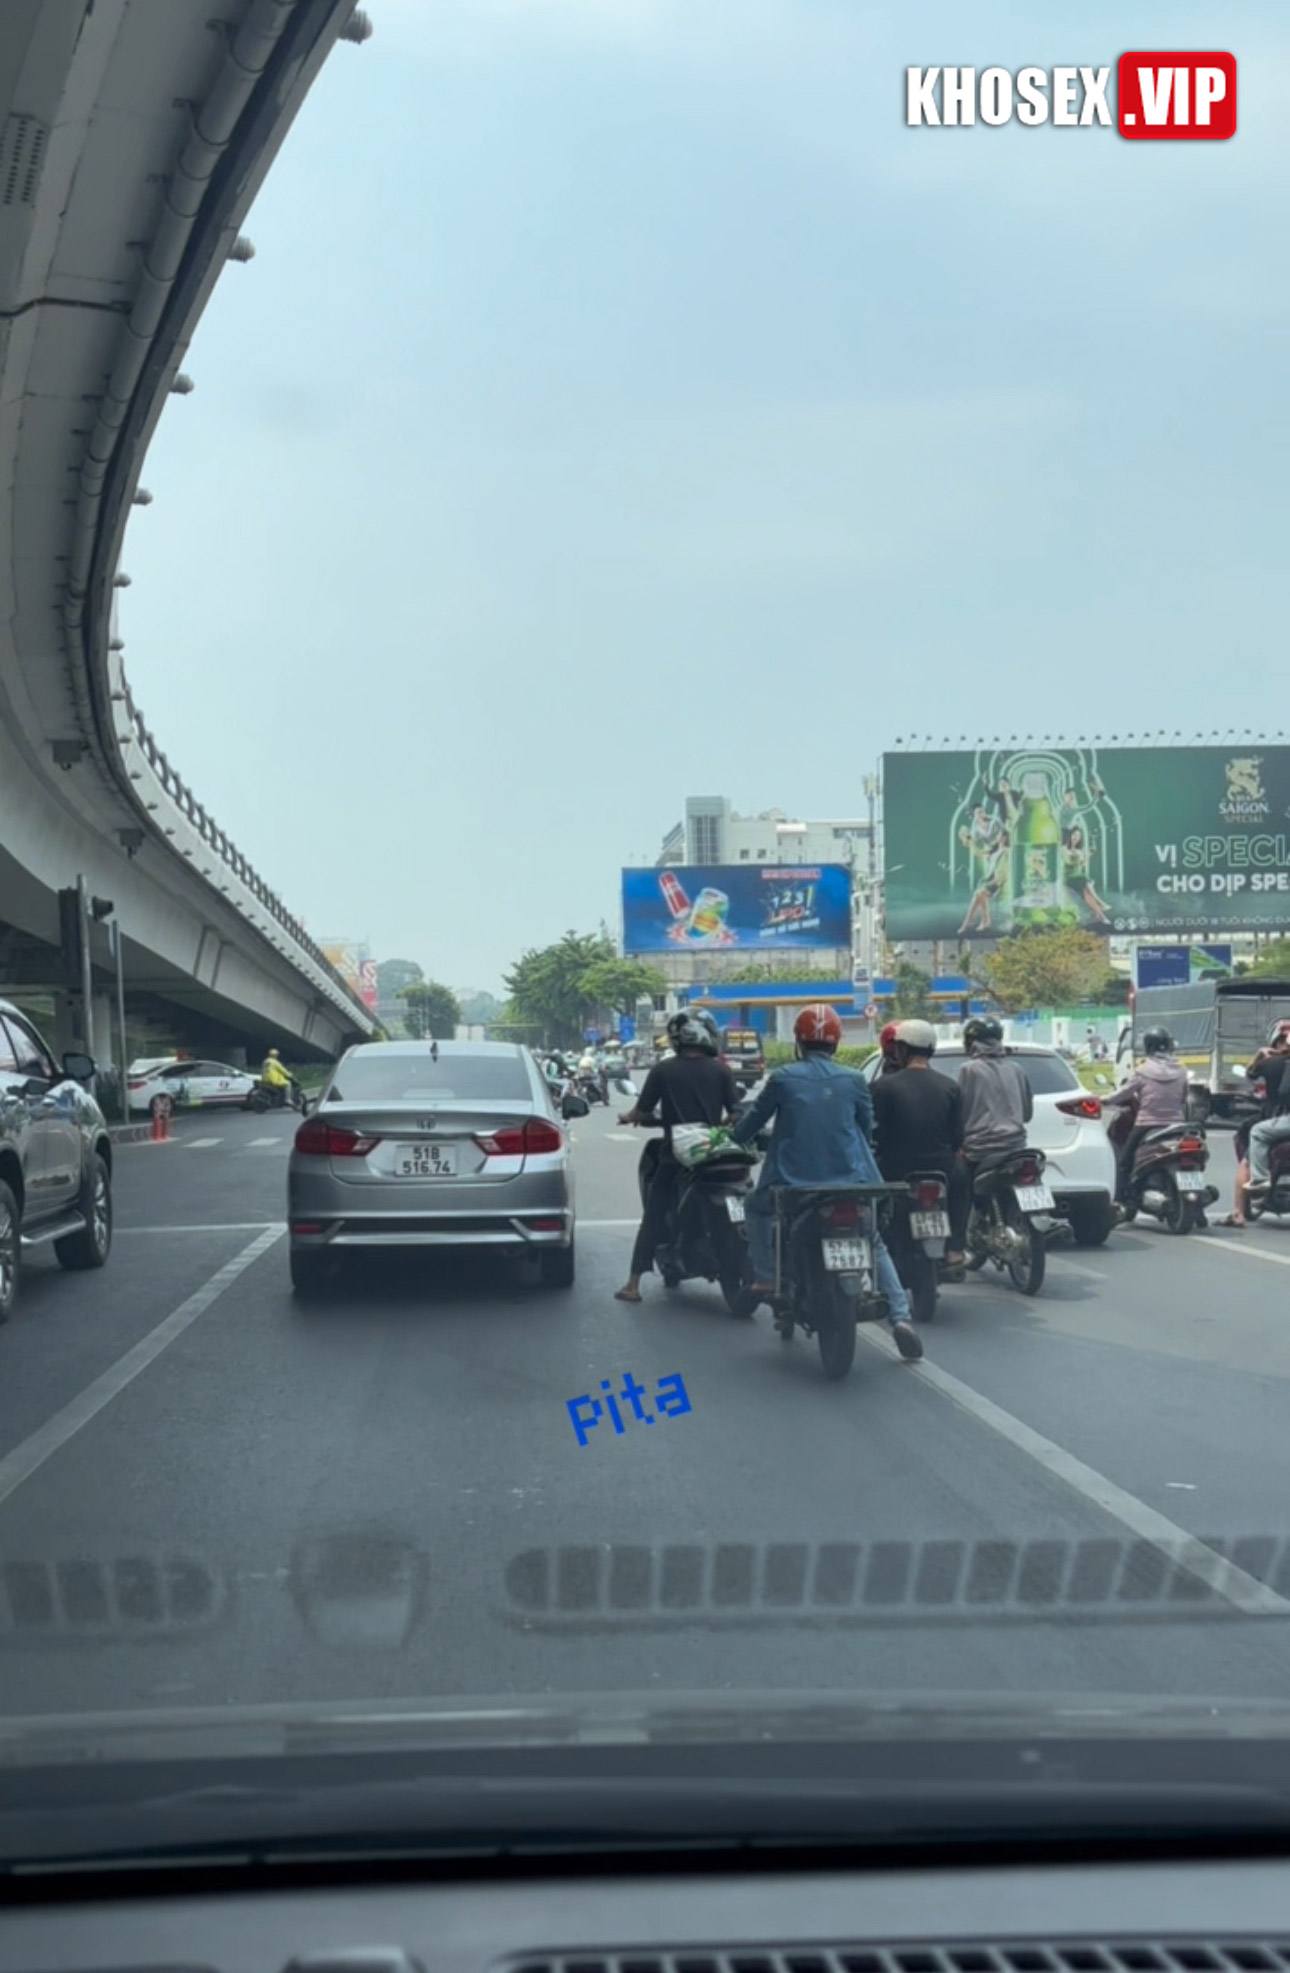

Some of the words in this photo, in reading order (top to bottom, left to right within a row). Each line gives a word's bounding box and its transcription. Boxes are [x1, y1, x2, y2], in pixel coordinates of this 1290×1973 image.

[1219, 801, 1269, 814] SAIGON
[1155, 844, 1177, 868] VỊ
[1182, 834, 1290, 868] SPECI
[1156, 874, 1205, 893] CHO
[1210, 873, 1246, 897] DỊP
[403, 1160, 451, 1174] 516.74
